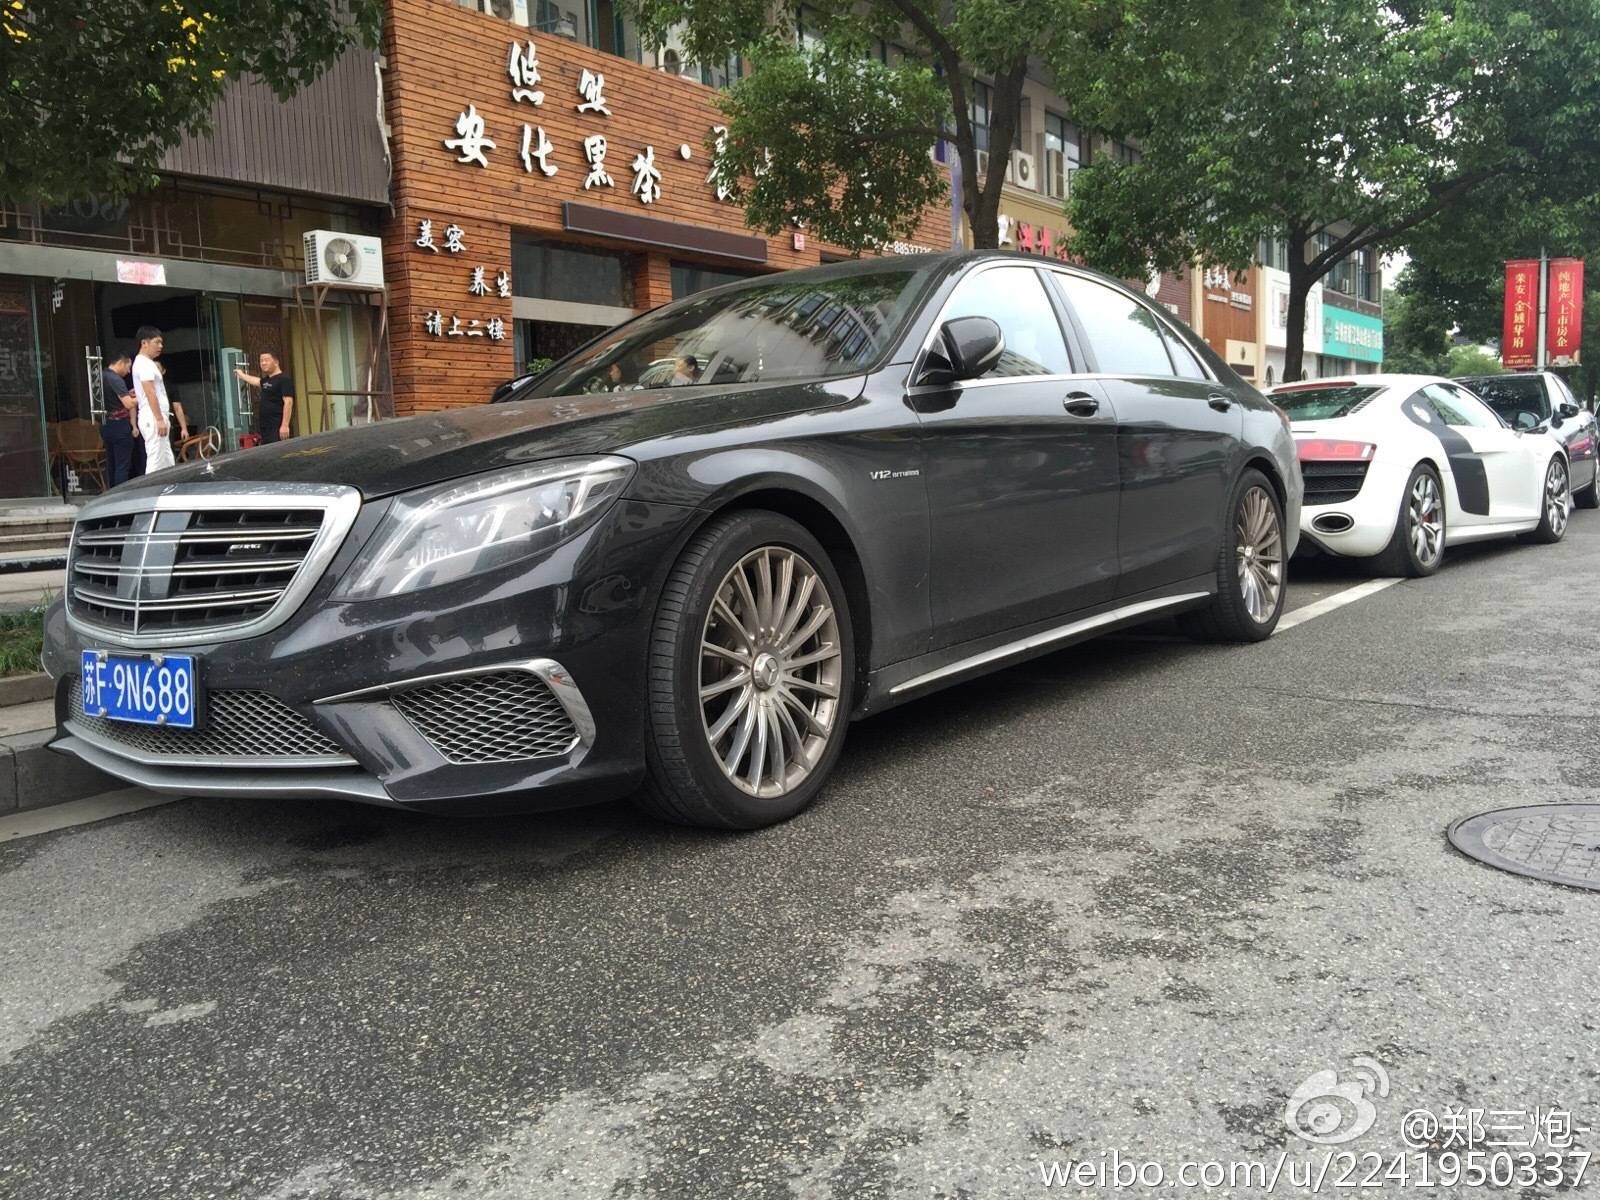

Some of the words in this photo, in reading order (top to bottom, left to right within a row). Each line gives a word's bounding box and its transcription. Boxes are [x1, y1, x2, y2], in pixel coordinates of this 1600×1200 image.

[416, 219, 467, 253] 美容
[467, 265, 511, 297] 养生
[424, 309, 506, 340] 请上二楼
[870, 470, 891, 480] V12
